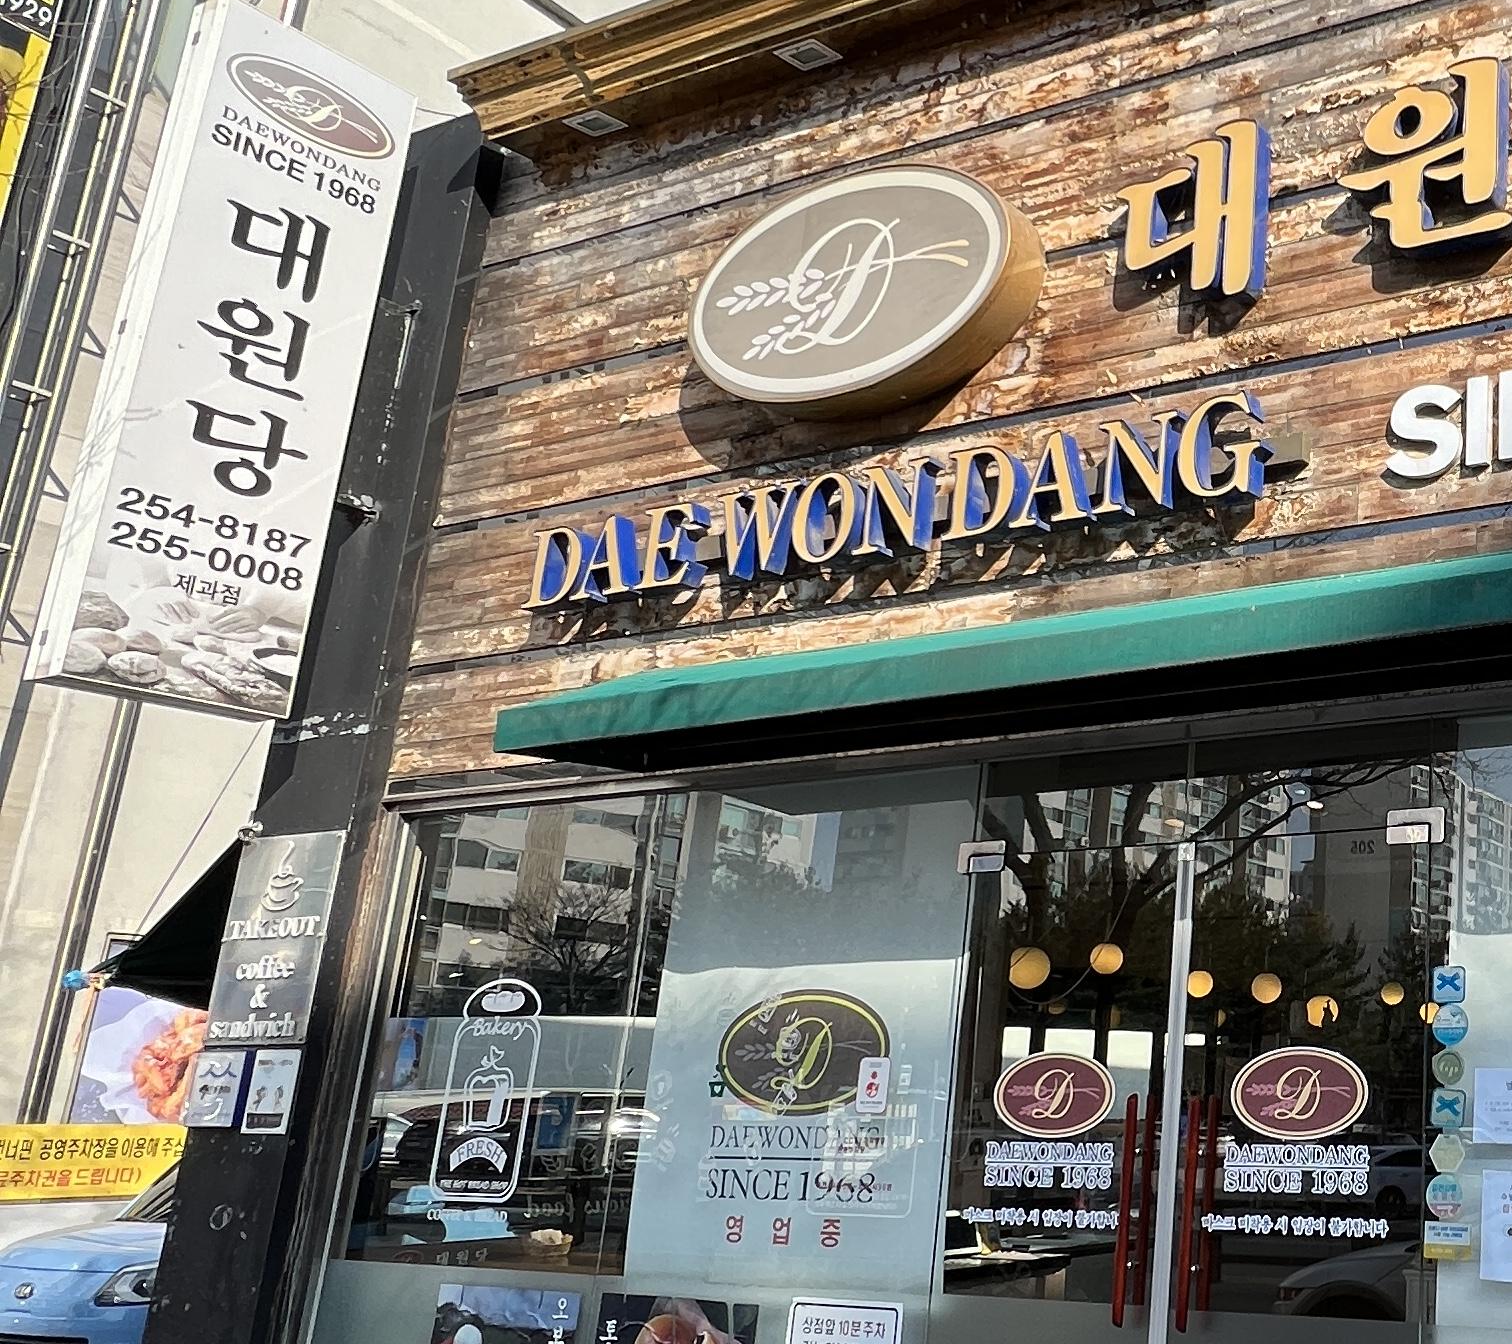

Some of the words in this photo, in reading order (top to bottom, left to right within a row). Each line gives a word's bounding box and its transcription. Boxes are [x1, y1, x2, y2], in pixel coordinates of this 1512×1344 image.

[222, 105, 382, 193] DAEWONDANG
[211, 123, 307, 183] SINCE
[314, 172, 376, 215] 1968
[116, 487, 312, 557] 254-8187
[107, 521, 303, 591] 255-0008
[173, 574, 242, 606] 제과점
[236, 954, 296, 980] coffee
[249, 983, 271, 1009] &
[209, 1011, 297, 1040] sandwich
[471, 1016, 527, 1041] Bakery
[39, 1137, 119, 1161] 공영주차장을
[456, 1139, 502, 1164] FRESH
[985, 1140, 1115, 1161] DAEWONDANG
[1225, 1143, 1370, 1165] DAEWONDANG
[706, 1168, 791, 1201] SINCE
[797, 1171, 876, 1203] 1968
[984, 1165, 1054, 1188] SINCE
[1061, 1166, 1112, 1190] 1968
[1223, 1169, 1302, 1194] SINCE
[1311, 1170, 1369, 1196] 1968
[962, 1206, 994, 1225] 마스크
[1075, 1209, 1119, 1230] 불가합니
[1201, 1213, 1236, 1233] 마스크
[1274, 1216, 1289, 1235] 시
[1291, 1216, 1327, 1236] 입장이
